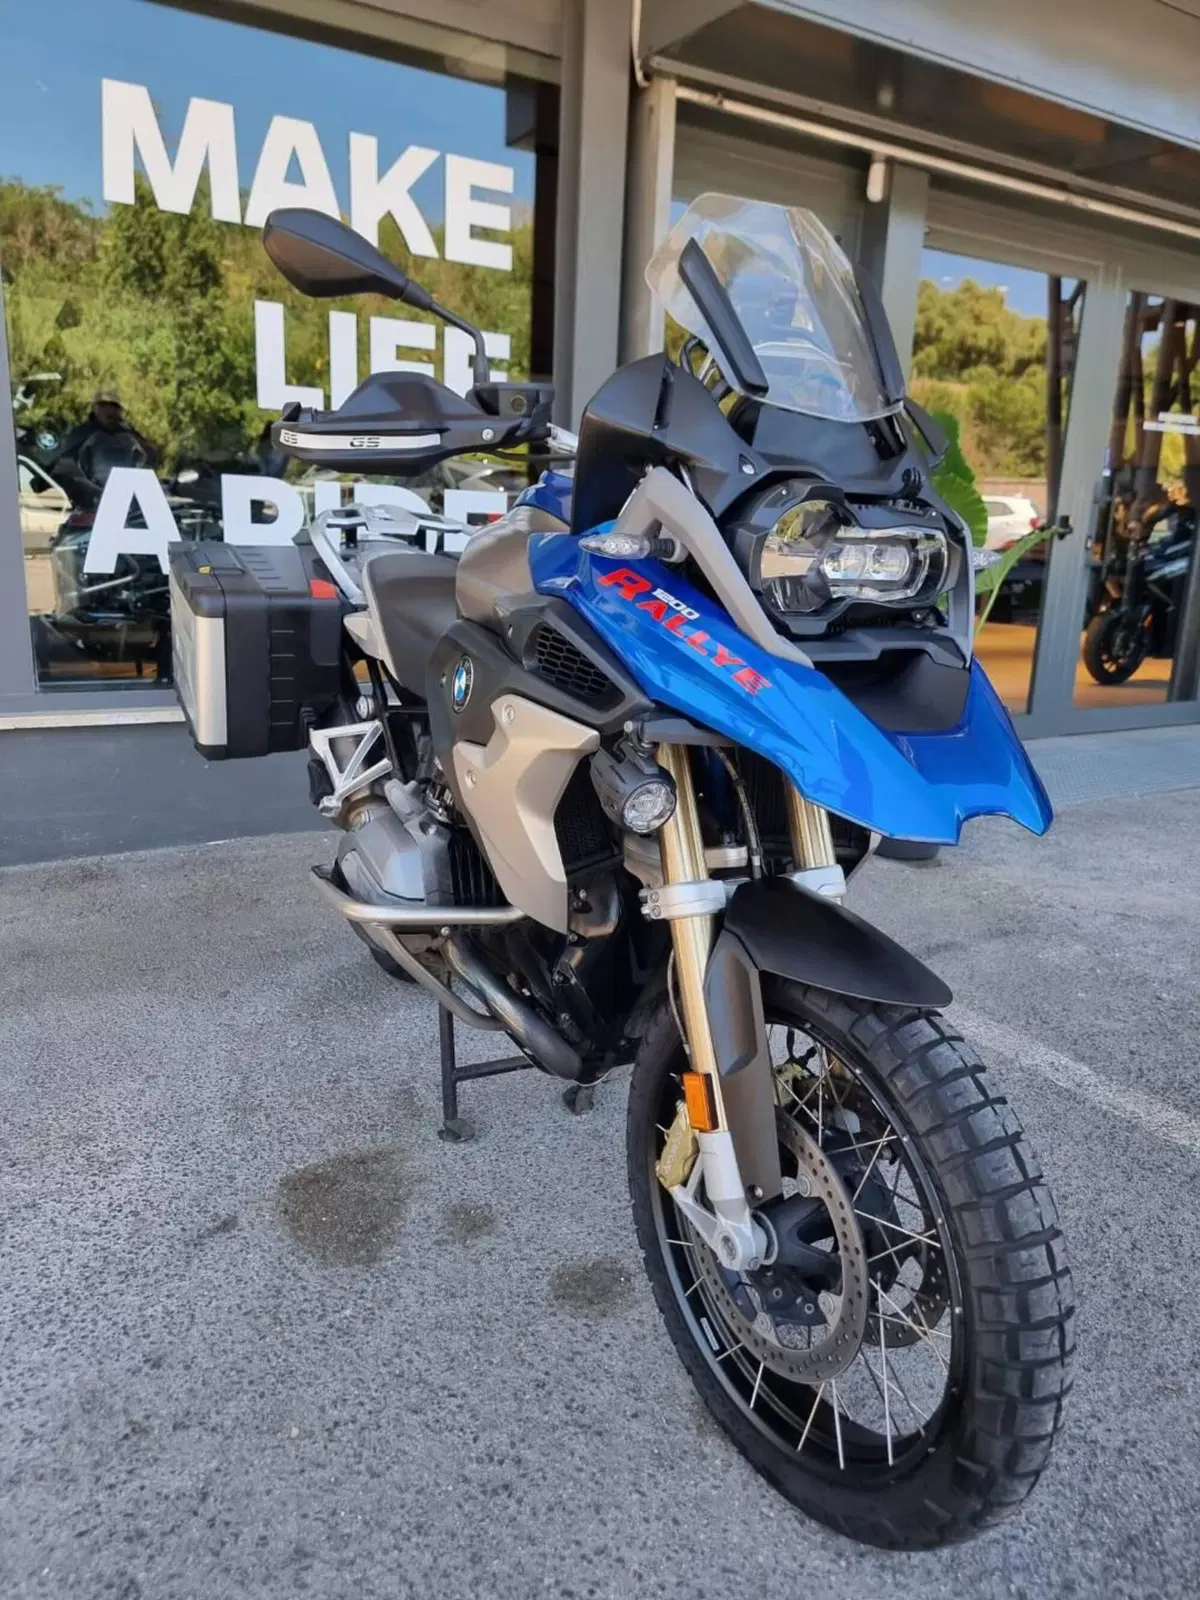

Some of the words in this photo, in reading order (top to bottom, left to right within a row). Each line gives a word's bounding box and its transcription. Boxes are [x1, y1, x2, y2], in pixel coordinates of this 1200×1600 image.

[101, 77, 515, 272] MAKE
[350, 436, 381, 448] GS
[82, 466, 182, 576] A
[597, 567, 773, 696] RALLYE
